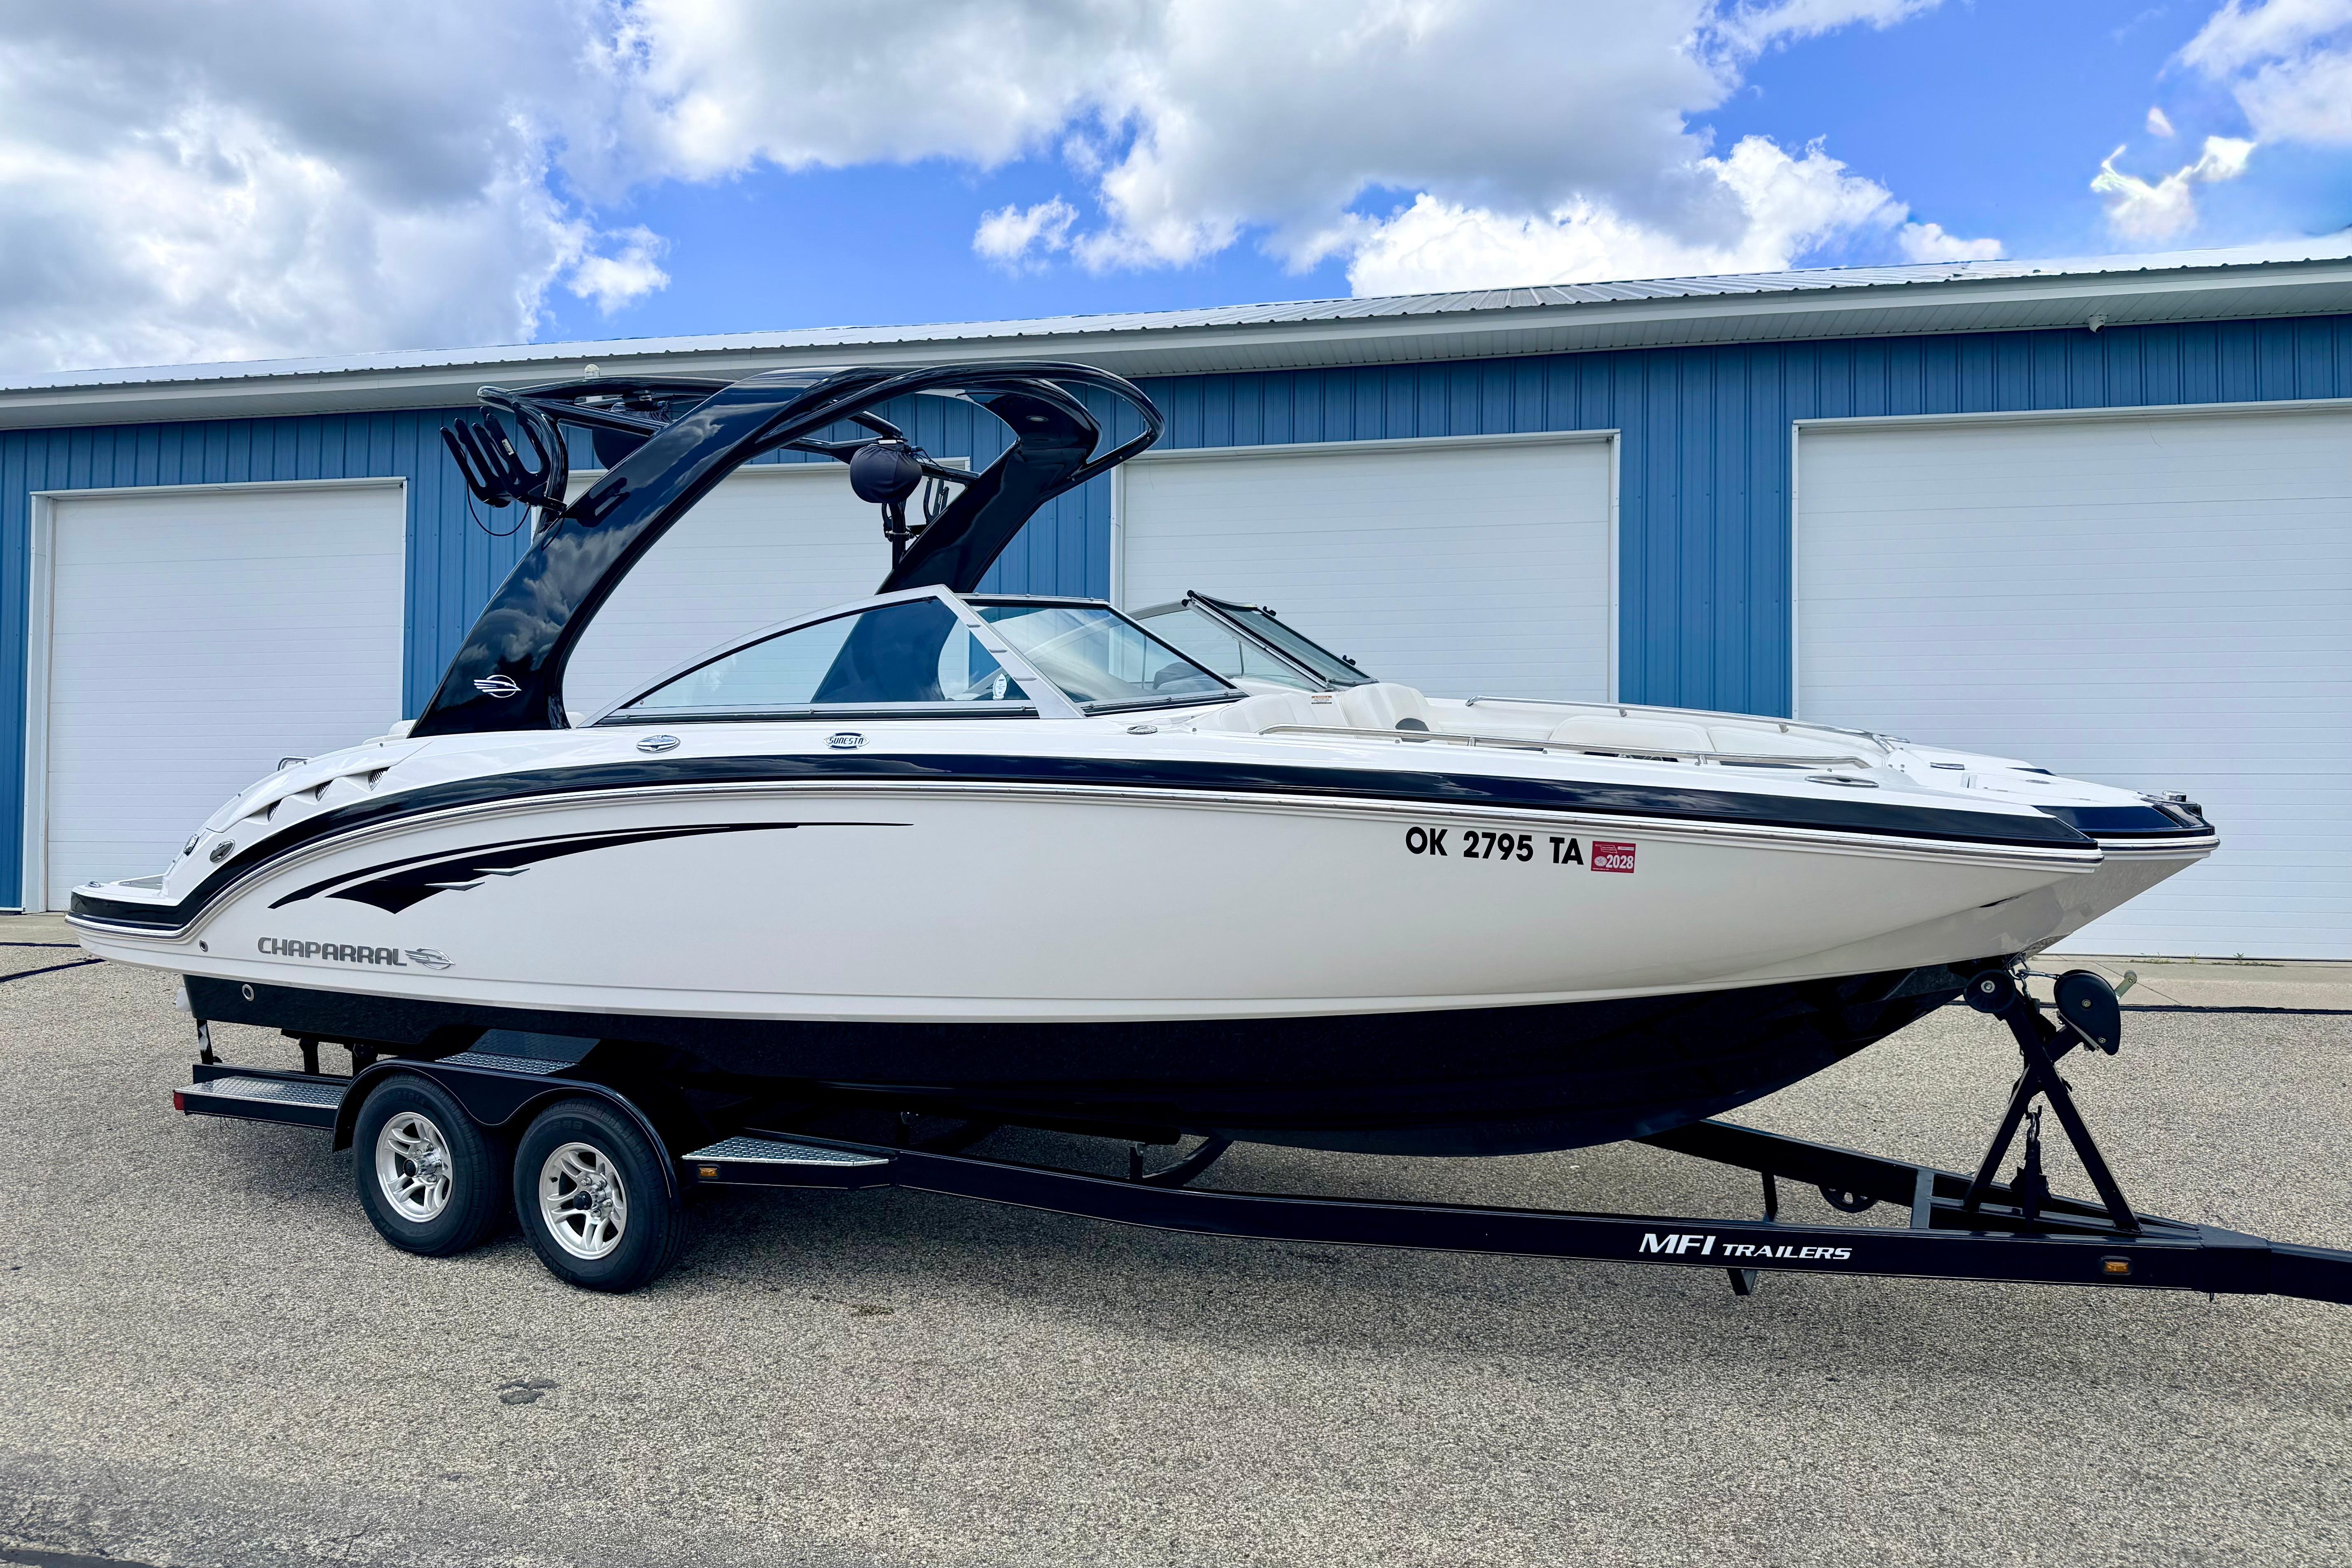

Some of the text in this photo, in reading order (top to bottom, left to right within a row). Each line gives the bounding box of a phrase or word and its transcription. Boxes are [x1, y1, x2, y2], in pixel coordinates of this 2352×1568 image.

[1405, 826, 1584, 865] OK 2795 TA
[1606, 854, 1634, 869] 2028
[258, 937, 407, 966] CHAPARRAL
[1639, 1233, 1853, 1260] MFI TRAILERS
